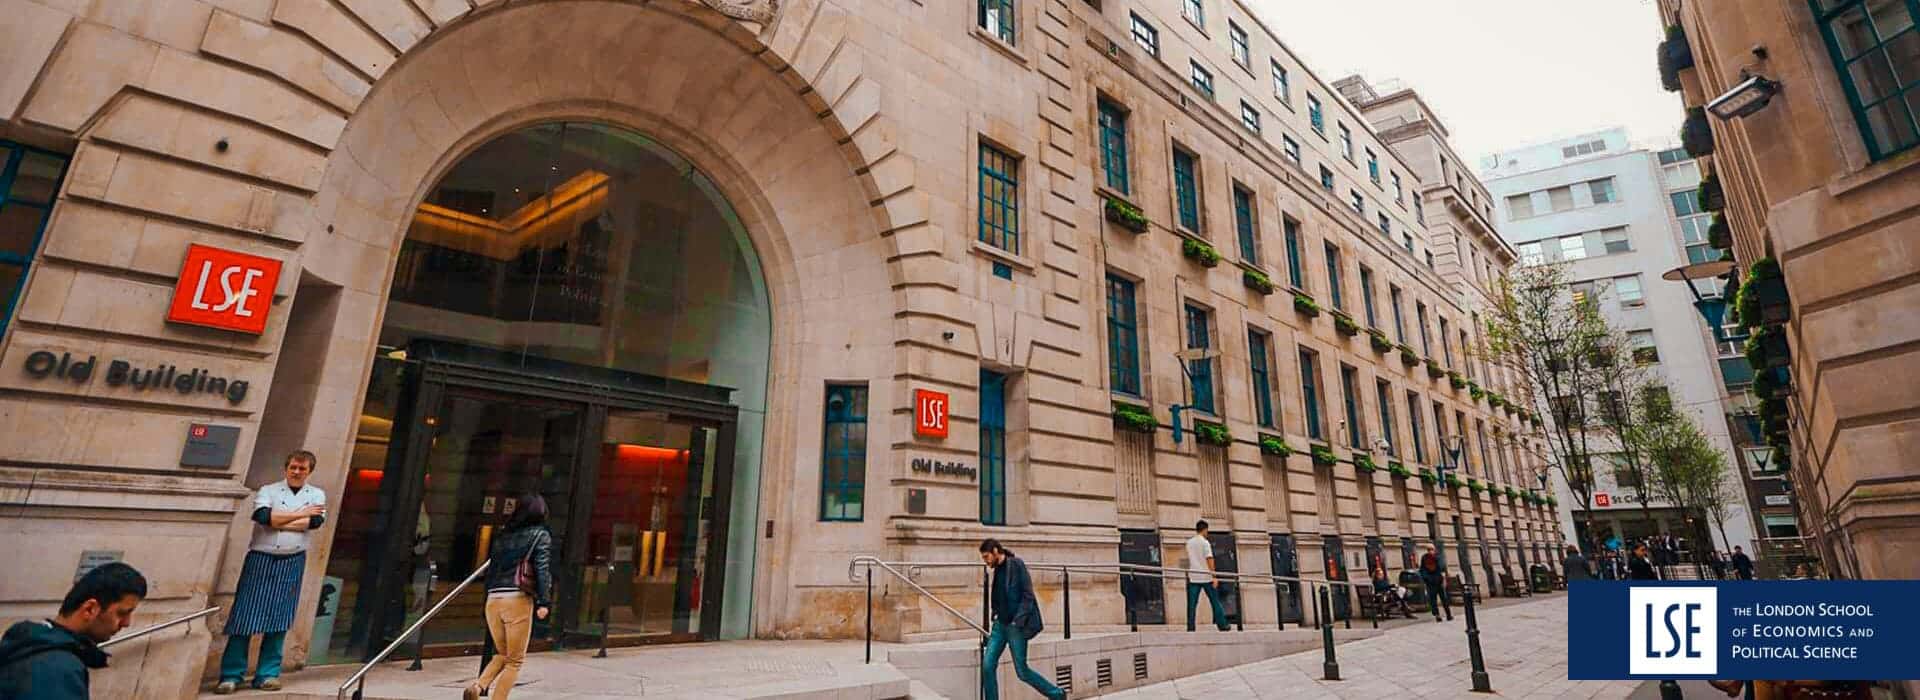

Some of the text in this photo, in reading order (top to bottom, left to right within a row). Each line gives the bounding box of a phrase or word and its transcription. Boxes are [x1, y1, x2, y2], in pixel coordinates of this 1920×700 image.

[191, 260, 263, 317] LSE
[24, 350, 249, 404] Old Building
[922, 397, 943, 429] LSE
[911, 458, 977, 481] Old Building
